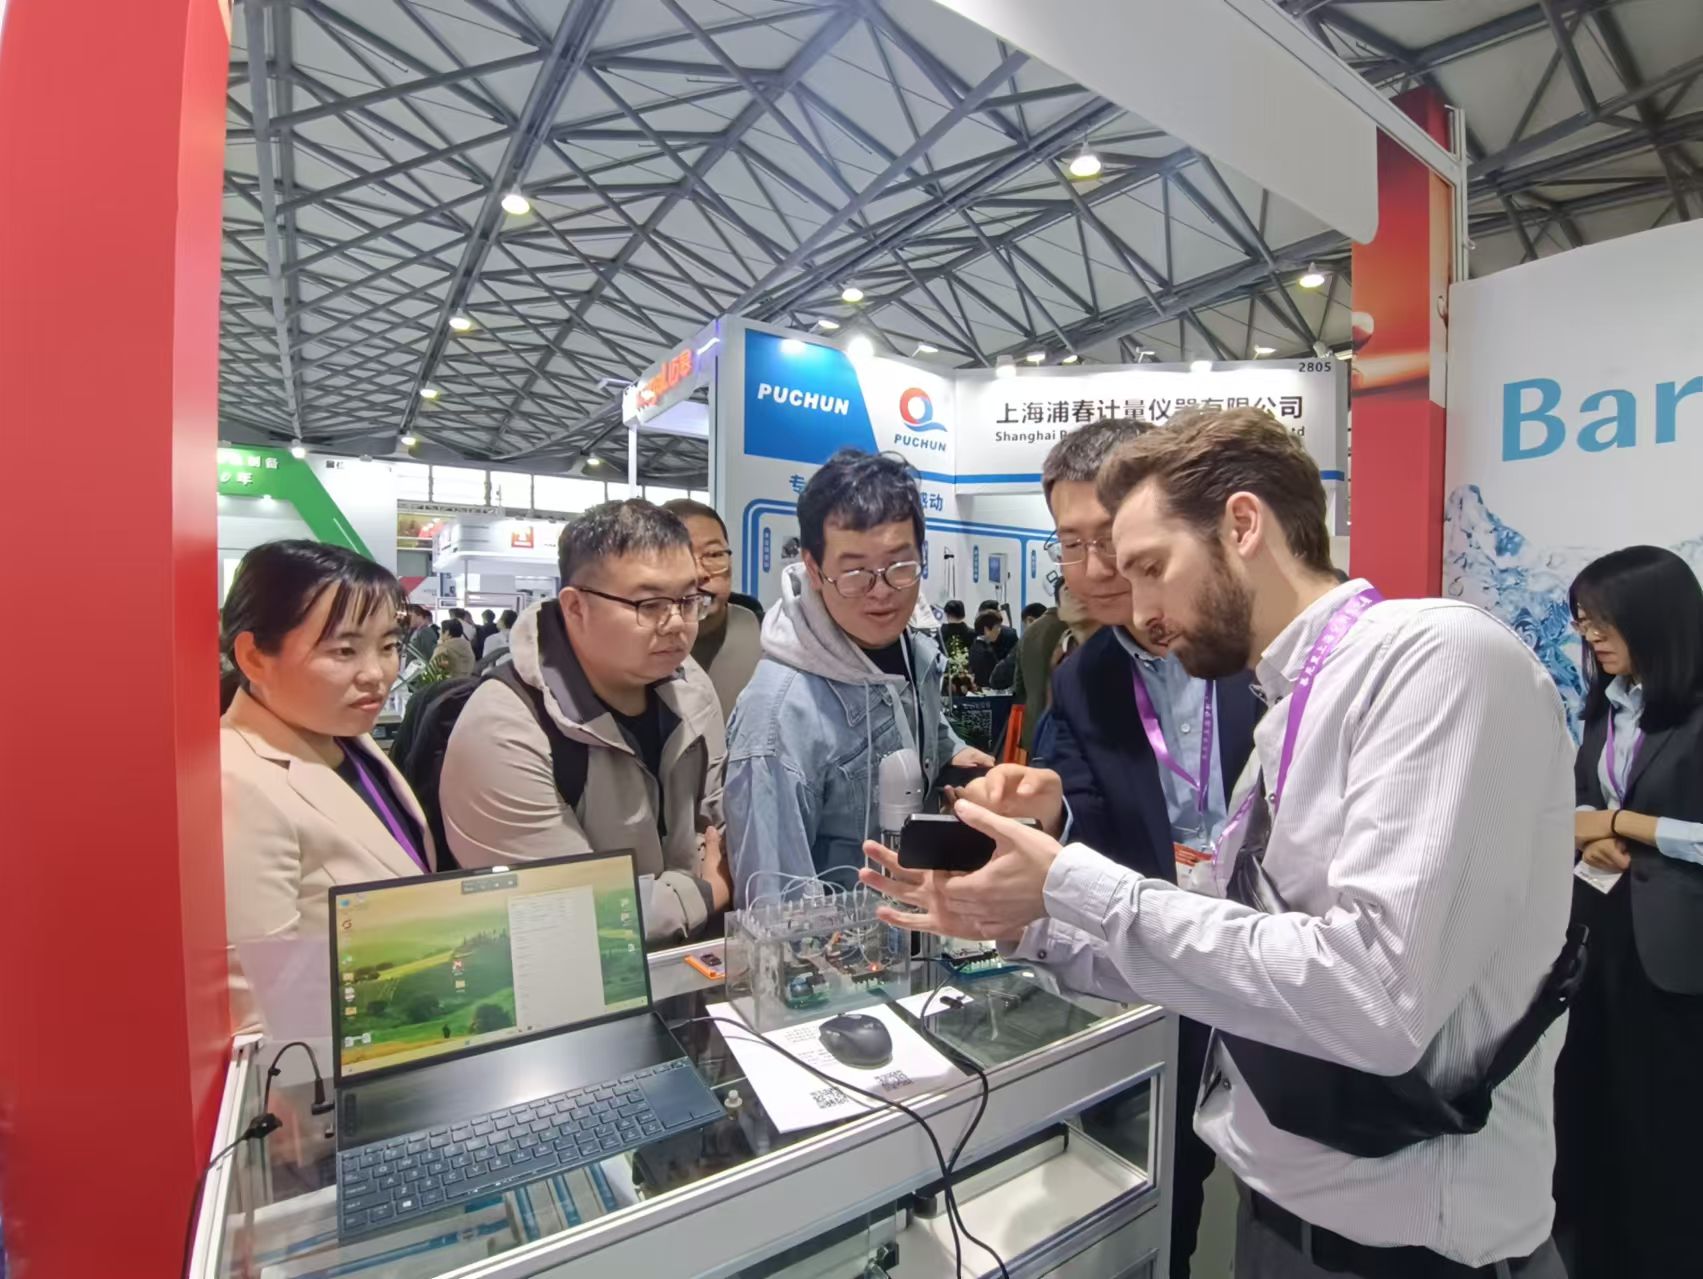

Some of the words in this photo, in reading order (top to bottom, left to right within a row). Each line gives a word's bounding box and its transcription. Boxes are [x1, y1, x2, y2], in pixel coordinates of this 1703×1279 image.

[1298, 361, 1332, 373] 2805
[757, 383, 850, 416] PUCHUN
[894, 433, 947, 452] PUCHUN
[995, 430, 1056, 443] Shanghai
